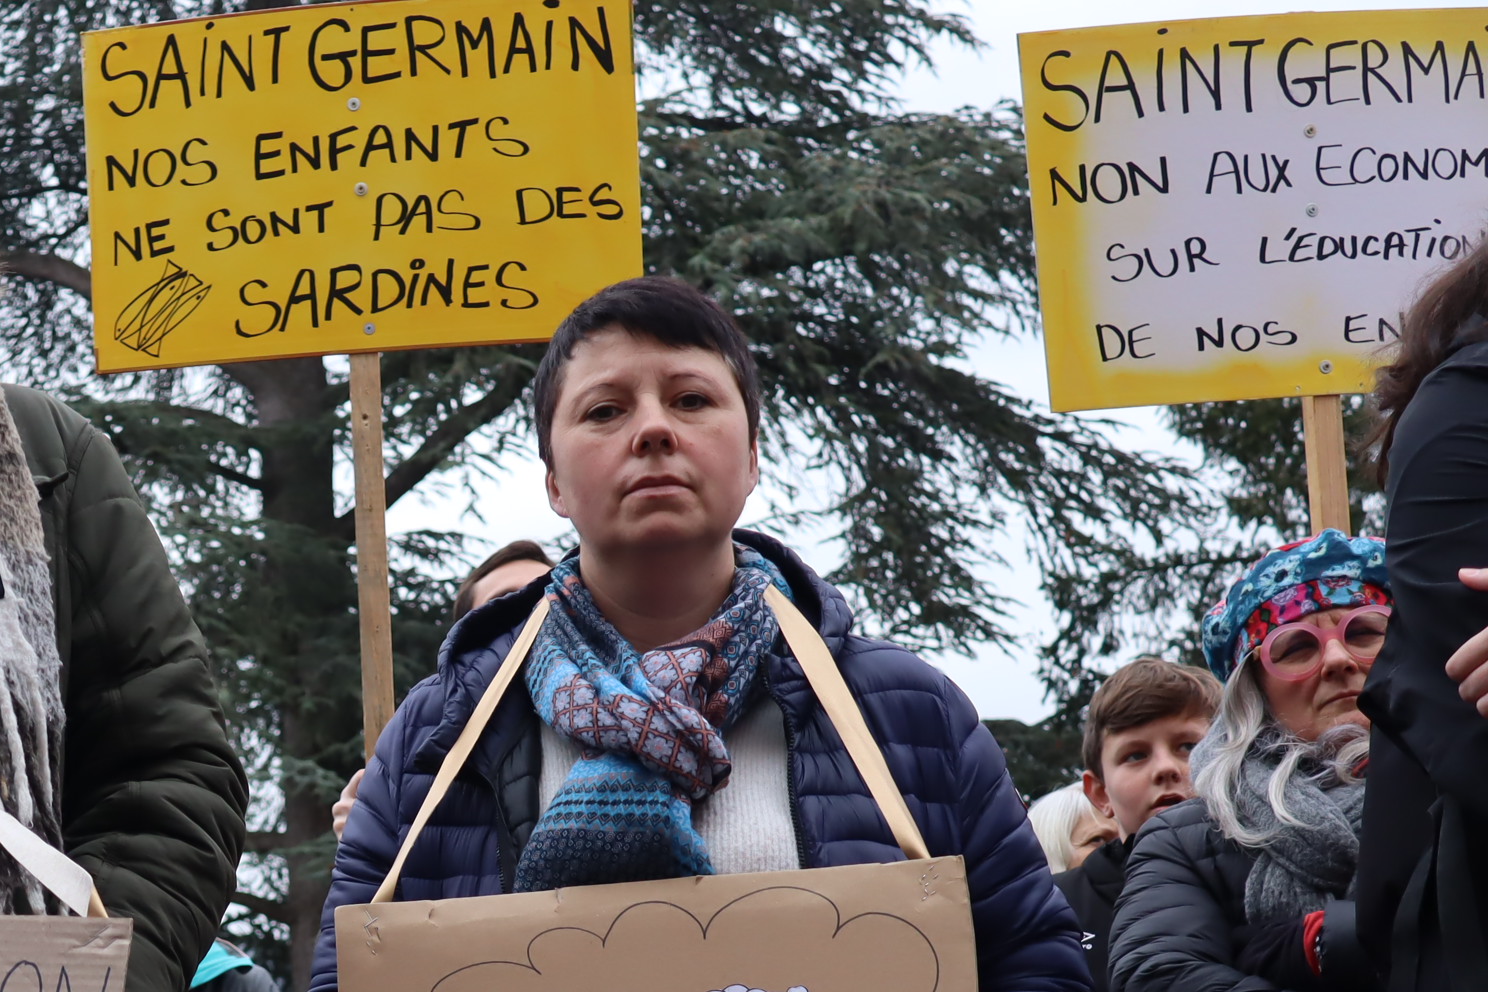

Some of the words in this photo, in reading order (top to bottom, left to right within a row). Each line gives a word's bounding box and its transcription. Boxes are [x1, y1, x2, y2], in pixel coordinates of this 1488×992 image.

[1277, 26, 1488, 108] GERMA
[105, 137, 218, 192] NOS
[254, 116, 530, 181] ENFANTS
[1049, 156, 1169, 206] NON
[1205, 150, 1293, 195] AUX
[113, 218, 176, 267] NE
[206, 200, 334, 252] SONT
[373, 189, 481, 242] PAS
[515, 182, 624, 225] DES
[1106, 236, 1220, 282] SUR
[1095, 323, 1156, 362] DE
[1196, 317, 1298, 352] NOS
